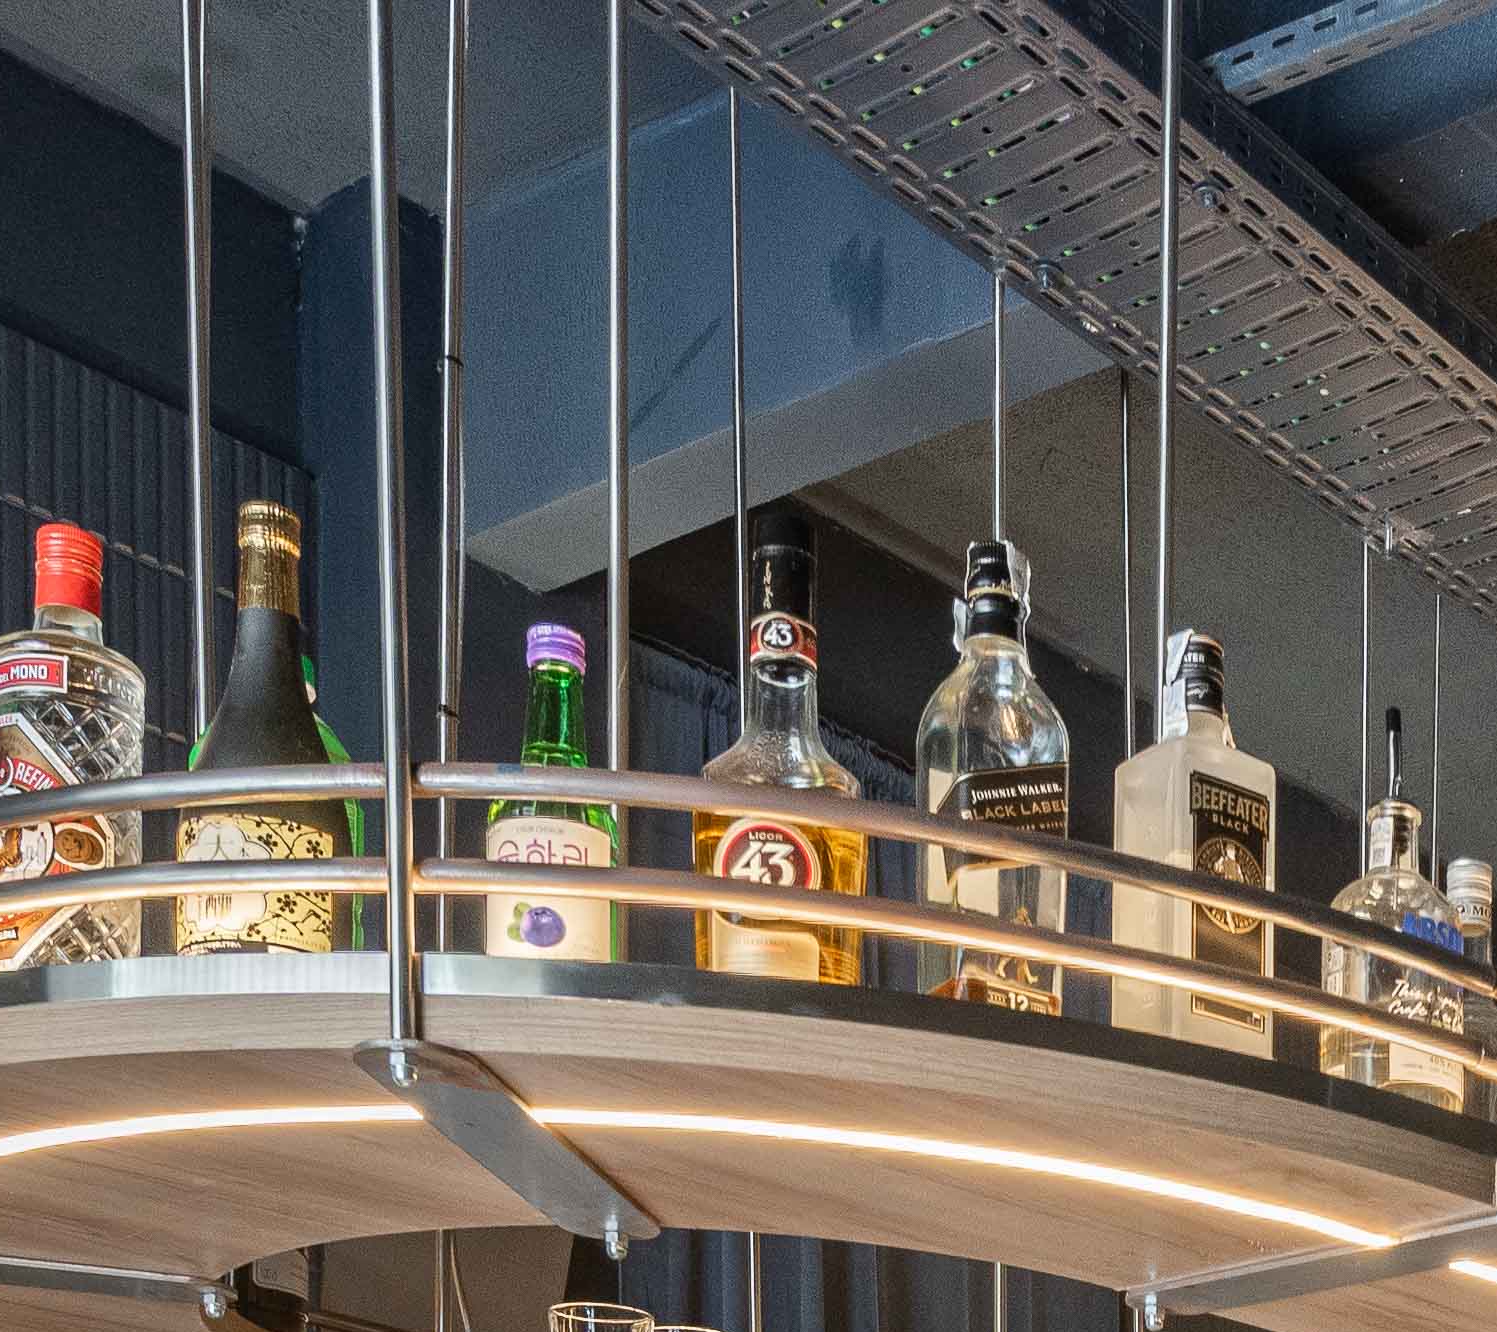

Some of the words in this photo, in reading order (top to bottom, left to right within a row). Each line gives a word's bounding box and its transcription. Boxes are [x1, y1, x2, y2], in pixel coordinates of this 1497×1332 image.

[10, 664, 48, 681] MONO
[970, 786, 1017, 805] JOHNNIE
[1020, 799, 1068, 816] LABEL
[1191, 780, 1269, 835] BEEFEATER
[1212, 812, 1249, 835] BLACK
[729, 841, 797, 887] 43
